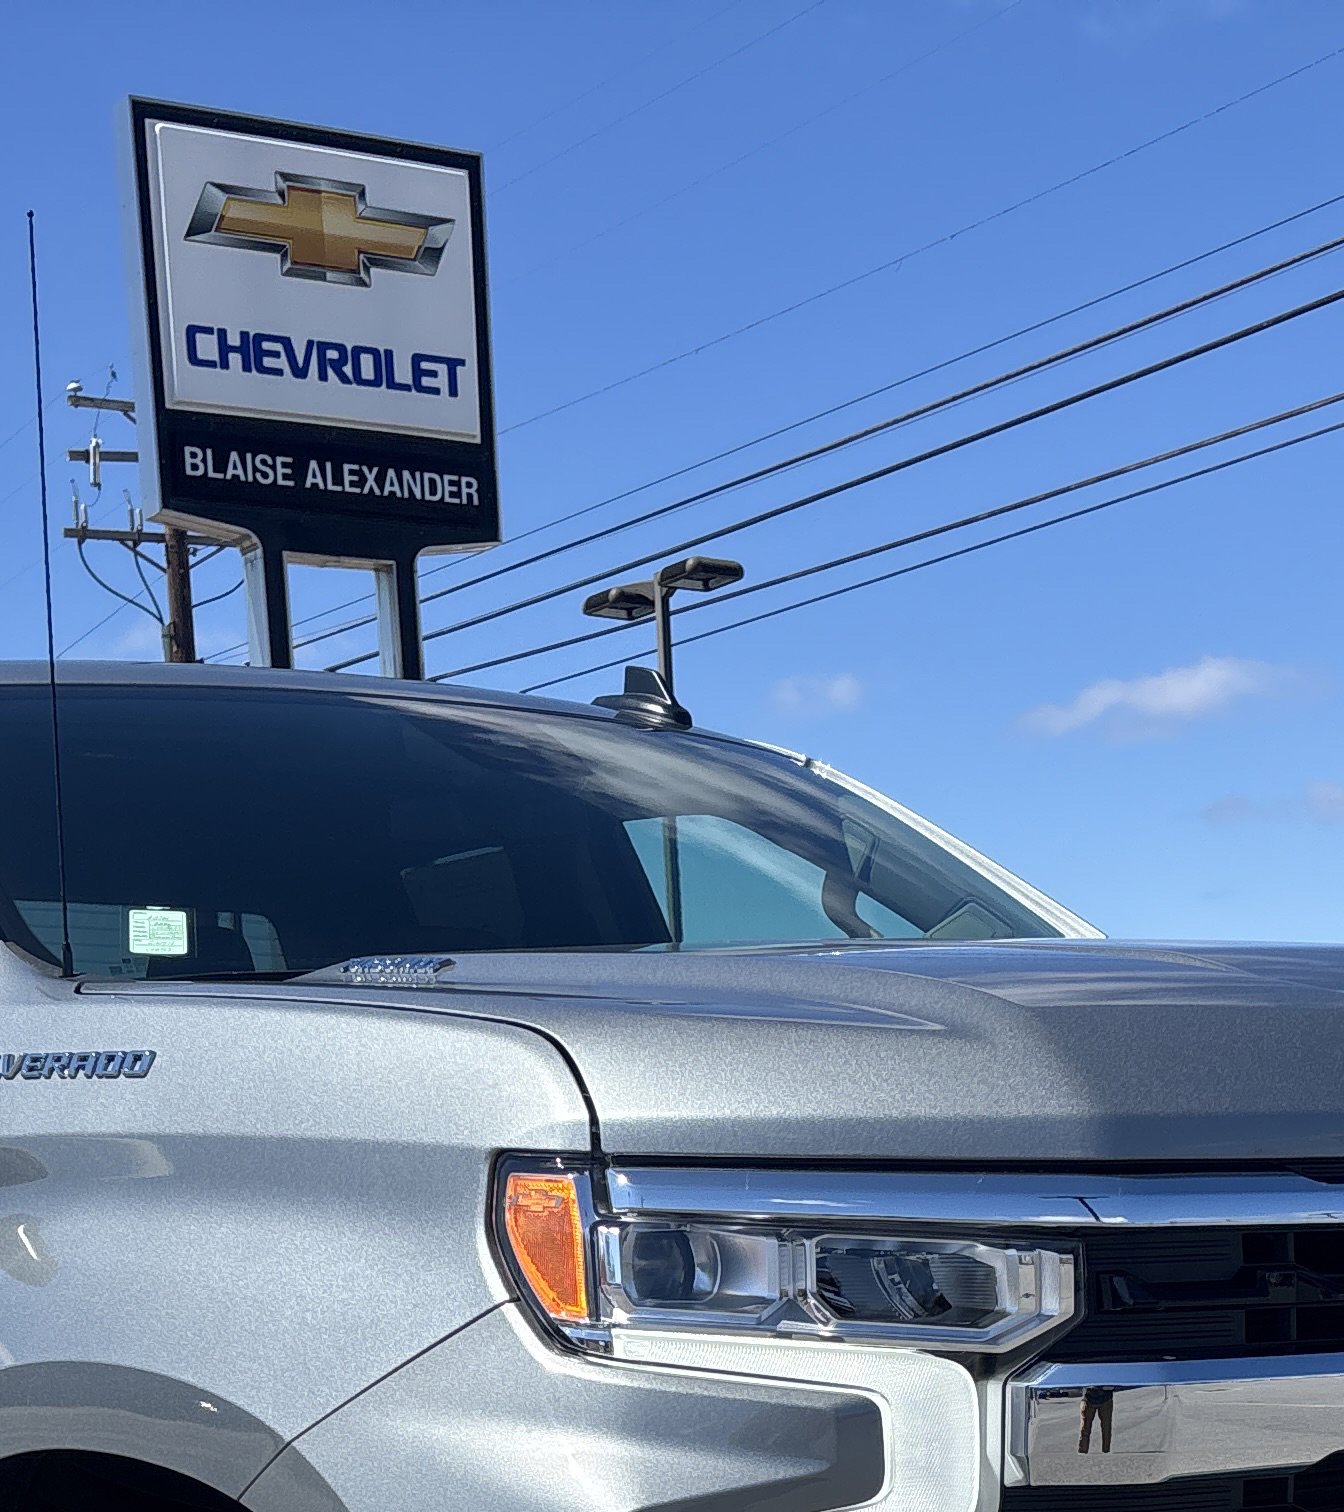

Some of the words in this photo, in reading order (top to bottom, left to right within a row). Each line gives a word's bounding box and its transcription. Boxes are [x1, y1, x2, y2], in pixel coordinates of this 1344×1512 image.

[185, 323, 466, 398] CHEVROLET
[183, 445, 295, 487] BLAISE
[305, 460, 480, 506] ALEXANDER
